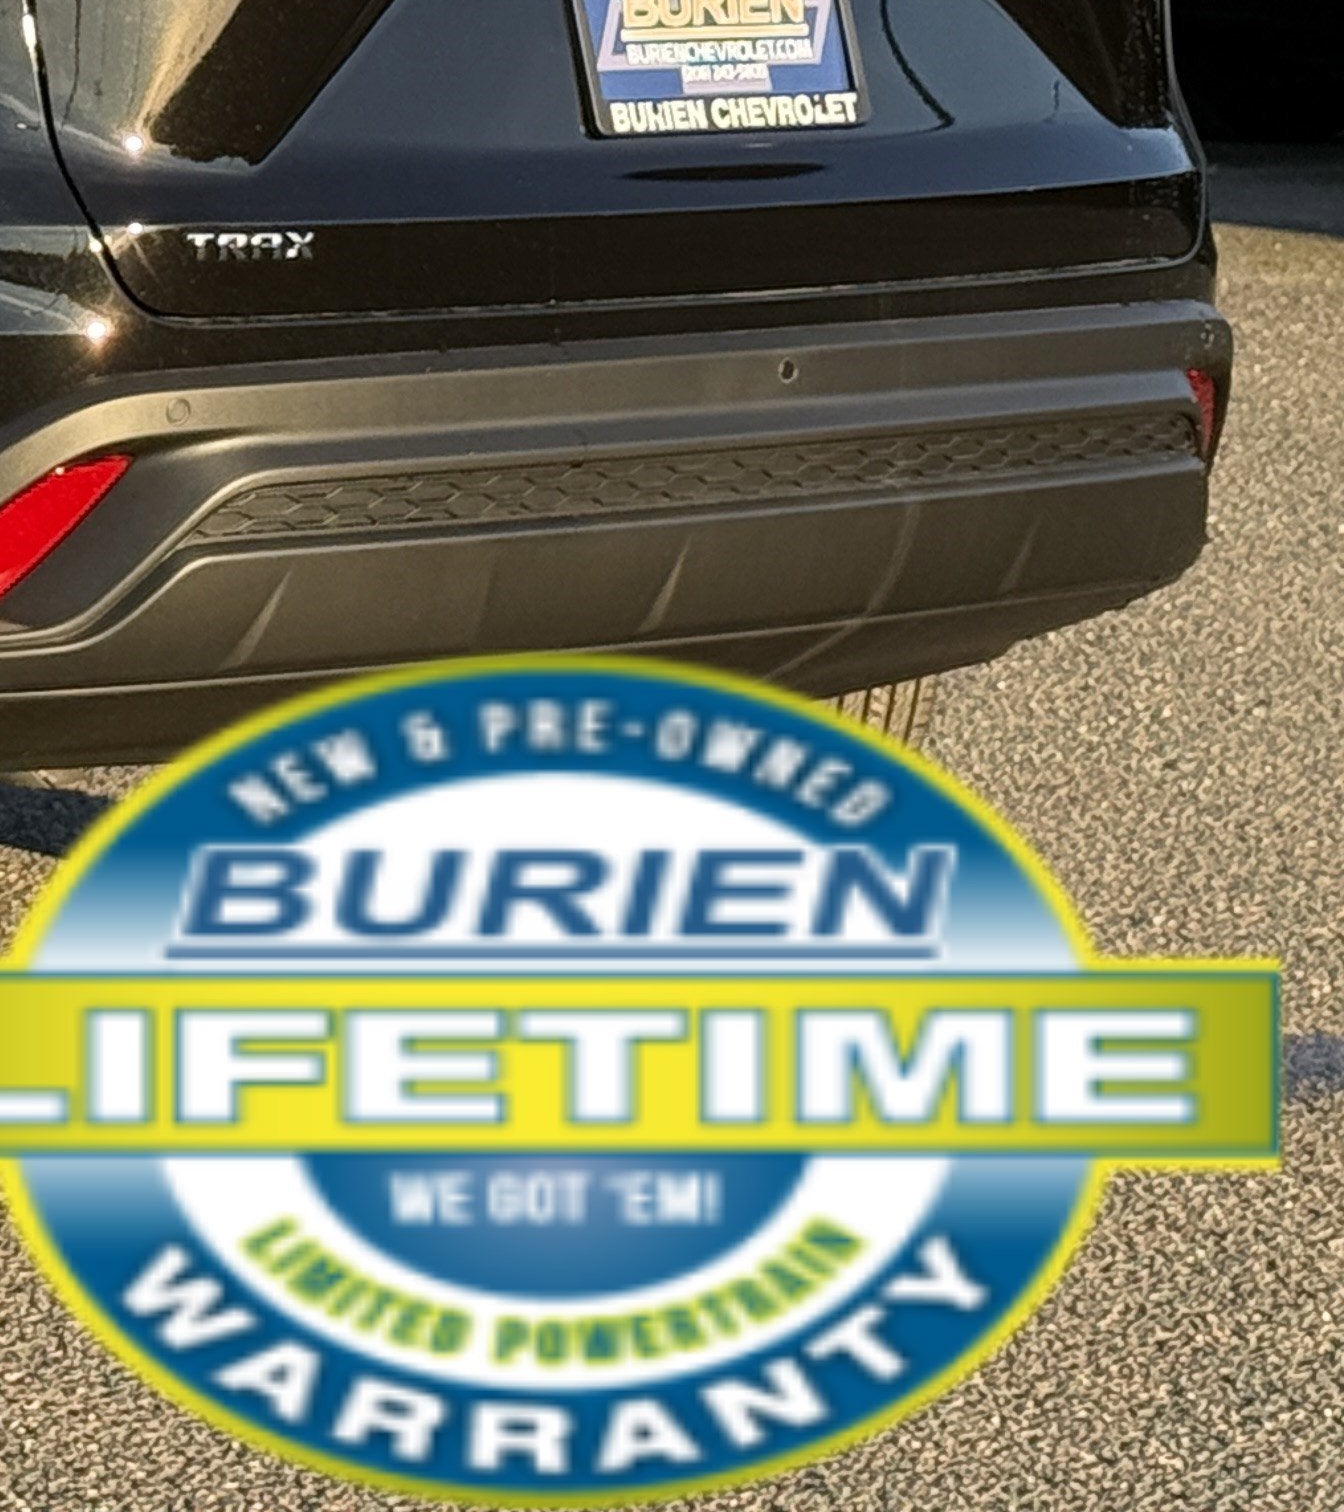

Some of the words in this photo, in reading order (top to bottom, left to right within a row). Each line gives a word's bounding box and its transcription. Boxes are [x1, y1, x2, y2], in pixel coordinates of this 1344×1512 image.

[611, 100, 708, 133] BURIEN
[711, 93, 858, 129] CHEVROLET
[186, 232, 315, 261] TRAX
